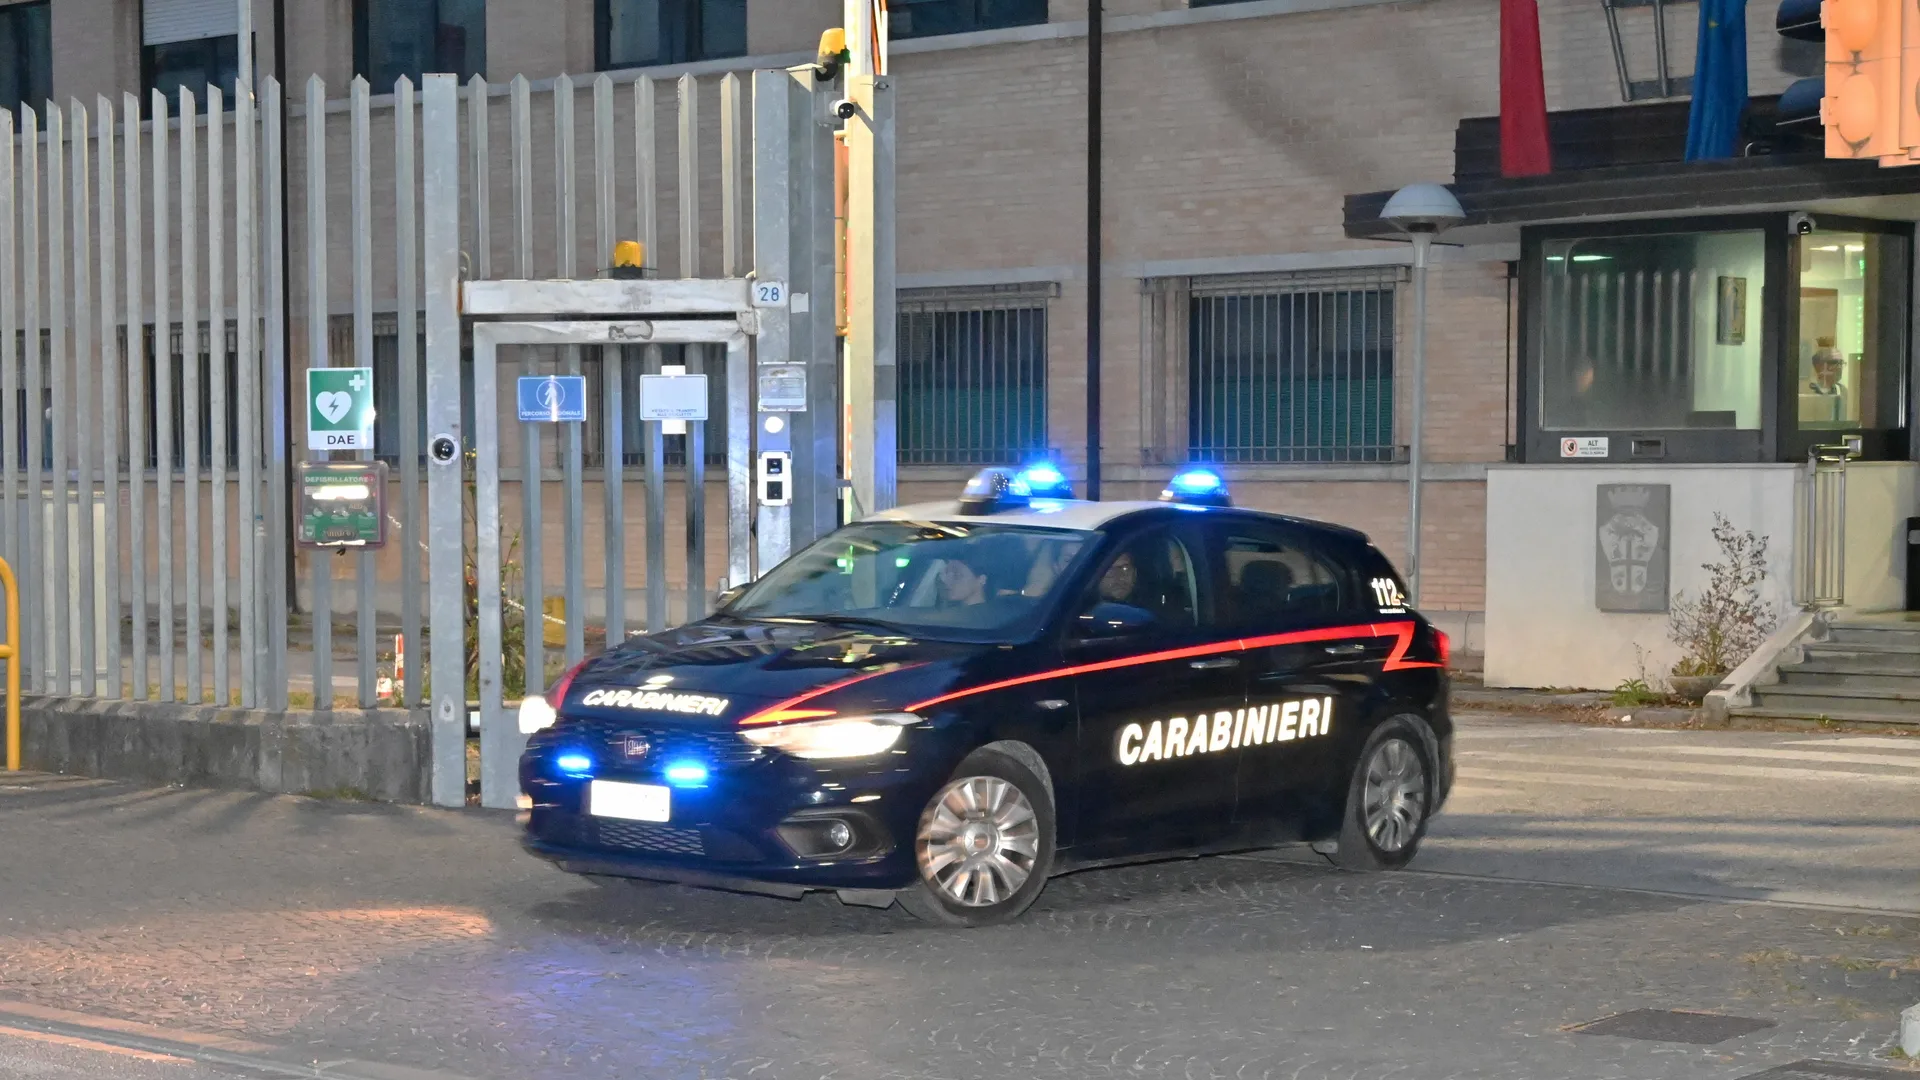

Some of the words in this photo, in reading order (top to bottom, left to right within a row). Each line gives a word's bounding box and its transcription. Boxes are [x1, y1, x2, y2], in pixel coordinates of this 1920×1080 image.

[760, 286, 780, 302] 28
[327, 435, 355, 445] DAE
[1371, 577, 1401, 606] 112
[582, 690, 729, 716] CARABINIERI
[1118, 696, 1332, 765] CARABINIERI
